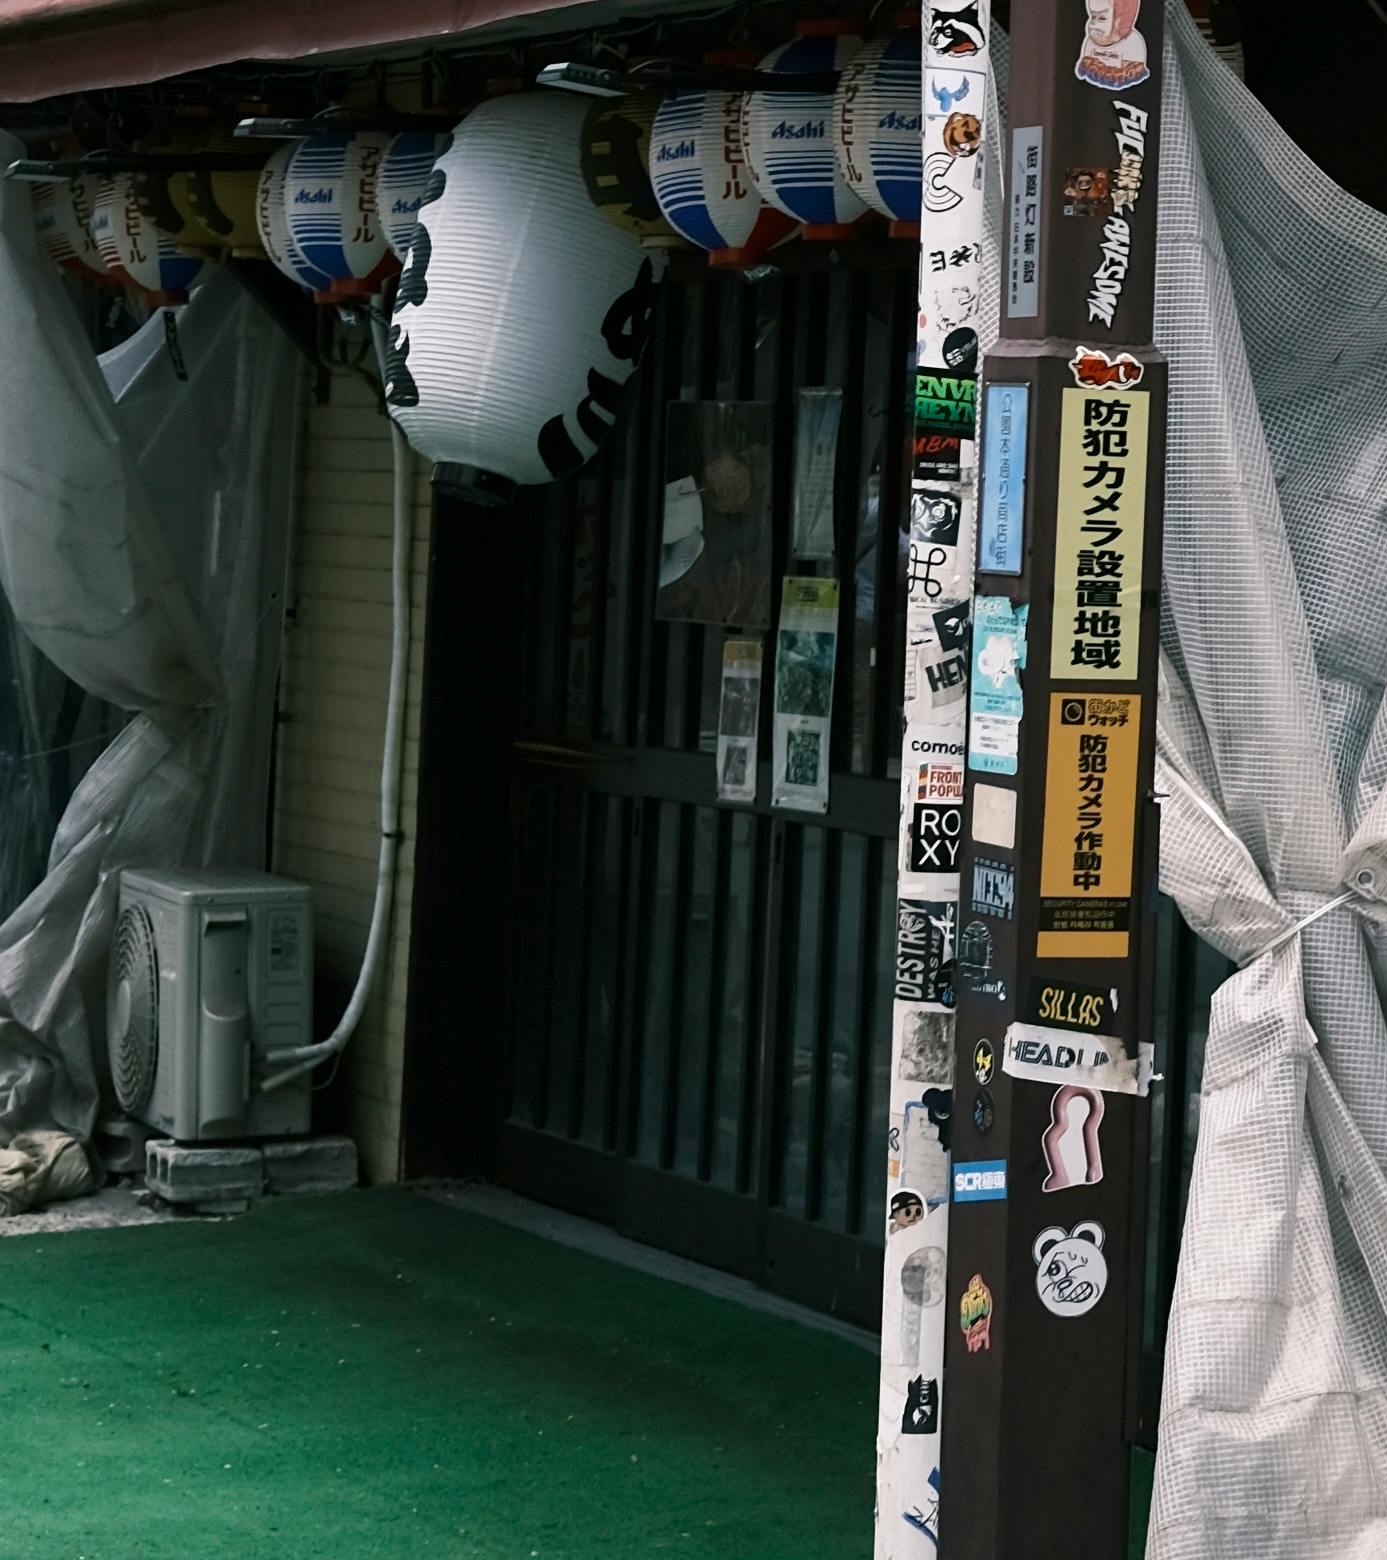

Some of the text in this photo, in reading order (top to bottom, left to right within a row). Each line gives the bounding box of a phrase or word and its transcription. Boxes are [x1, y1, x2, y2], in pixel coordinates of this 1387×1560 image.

[656, 139, 696, 162] Asahi
[771, 119, 826, 141] Asahi
[1085, 215, 1131, 330] AWESOME
[1071, 398, 1132, 670] 防犯カメラ設置地域
[1072, 733, 1109, 892] 防犯カメラ作動中
[1039, 986, 1105, 1027] SILLAS
